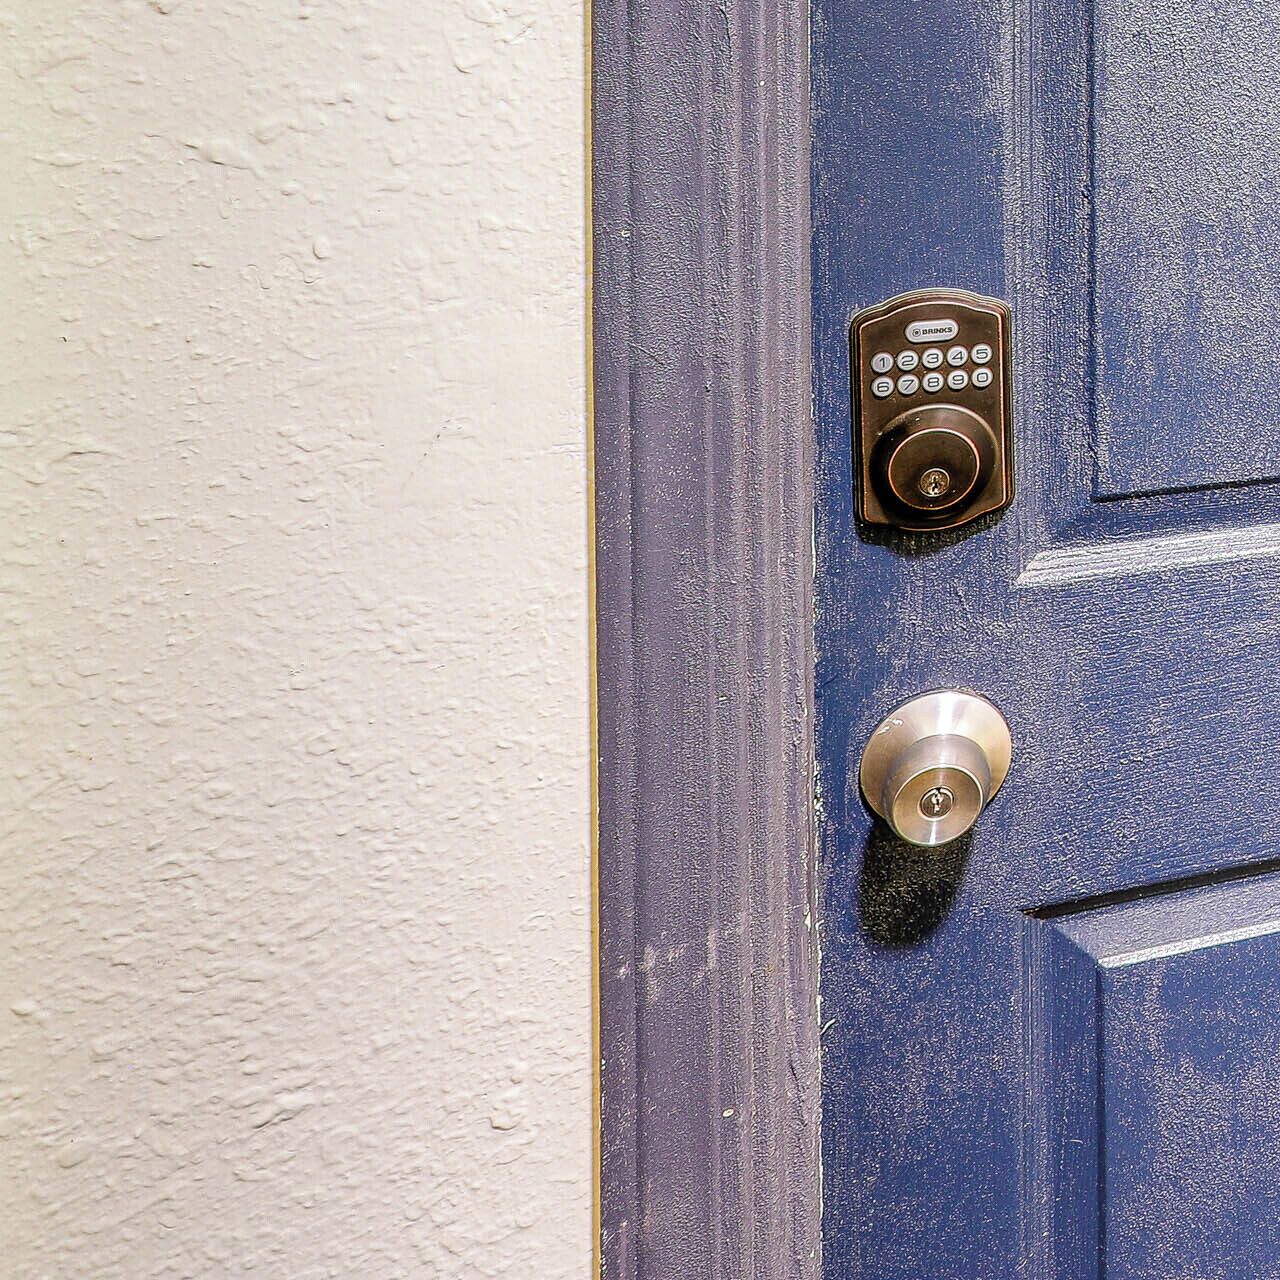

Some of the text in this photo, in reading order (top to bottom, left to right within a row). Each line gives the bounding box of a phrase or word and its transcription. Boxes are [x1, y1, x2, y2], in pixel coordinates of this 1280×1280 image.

[901, 355, 915, 366] 2
[926, 353, 940, 364] 3
[951, 351, 964, 362] 4
[975, 349, 989, 360] 5
[876, 372, 989, 393] 6 7 8 9 0
